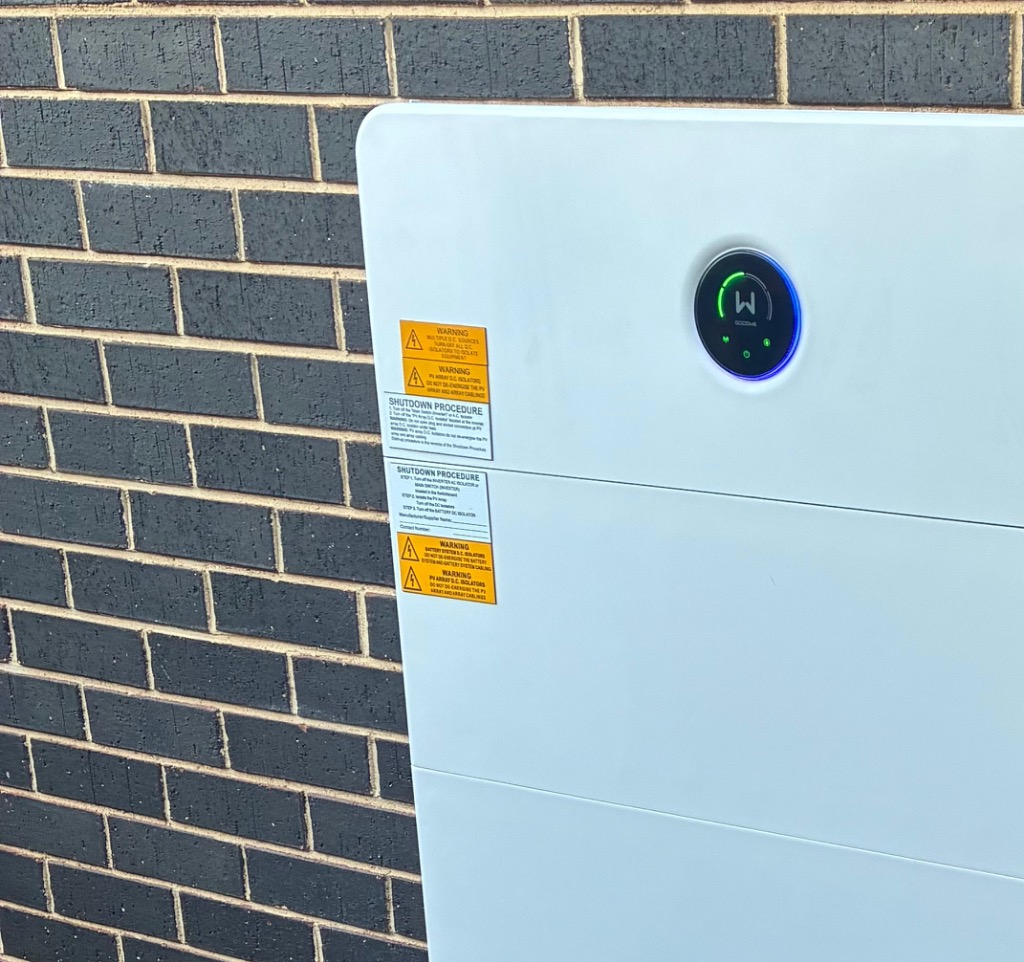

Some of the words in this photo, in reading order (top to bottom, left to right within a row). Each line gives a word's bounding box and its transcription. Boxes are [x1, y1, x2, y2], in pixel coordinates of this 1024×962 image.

[436, 327, 469, 337] WARNING
[438, 366, 471, 376] WARNING
[389, 398, 432, 410] SHUTDOWN
[434, 402, 484, 416] PROCEDURE
[397, 466, 436, 476] SHUTDOWN
[436, 470, 480, 481] PROCEDURE
[440, 540, 470, 550] WARNING
[442, 570, 472, 580] WARNING
